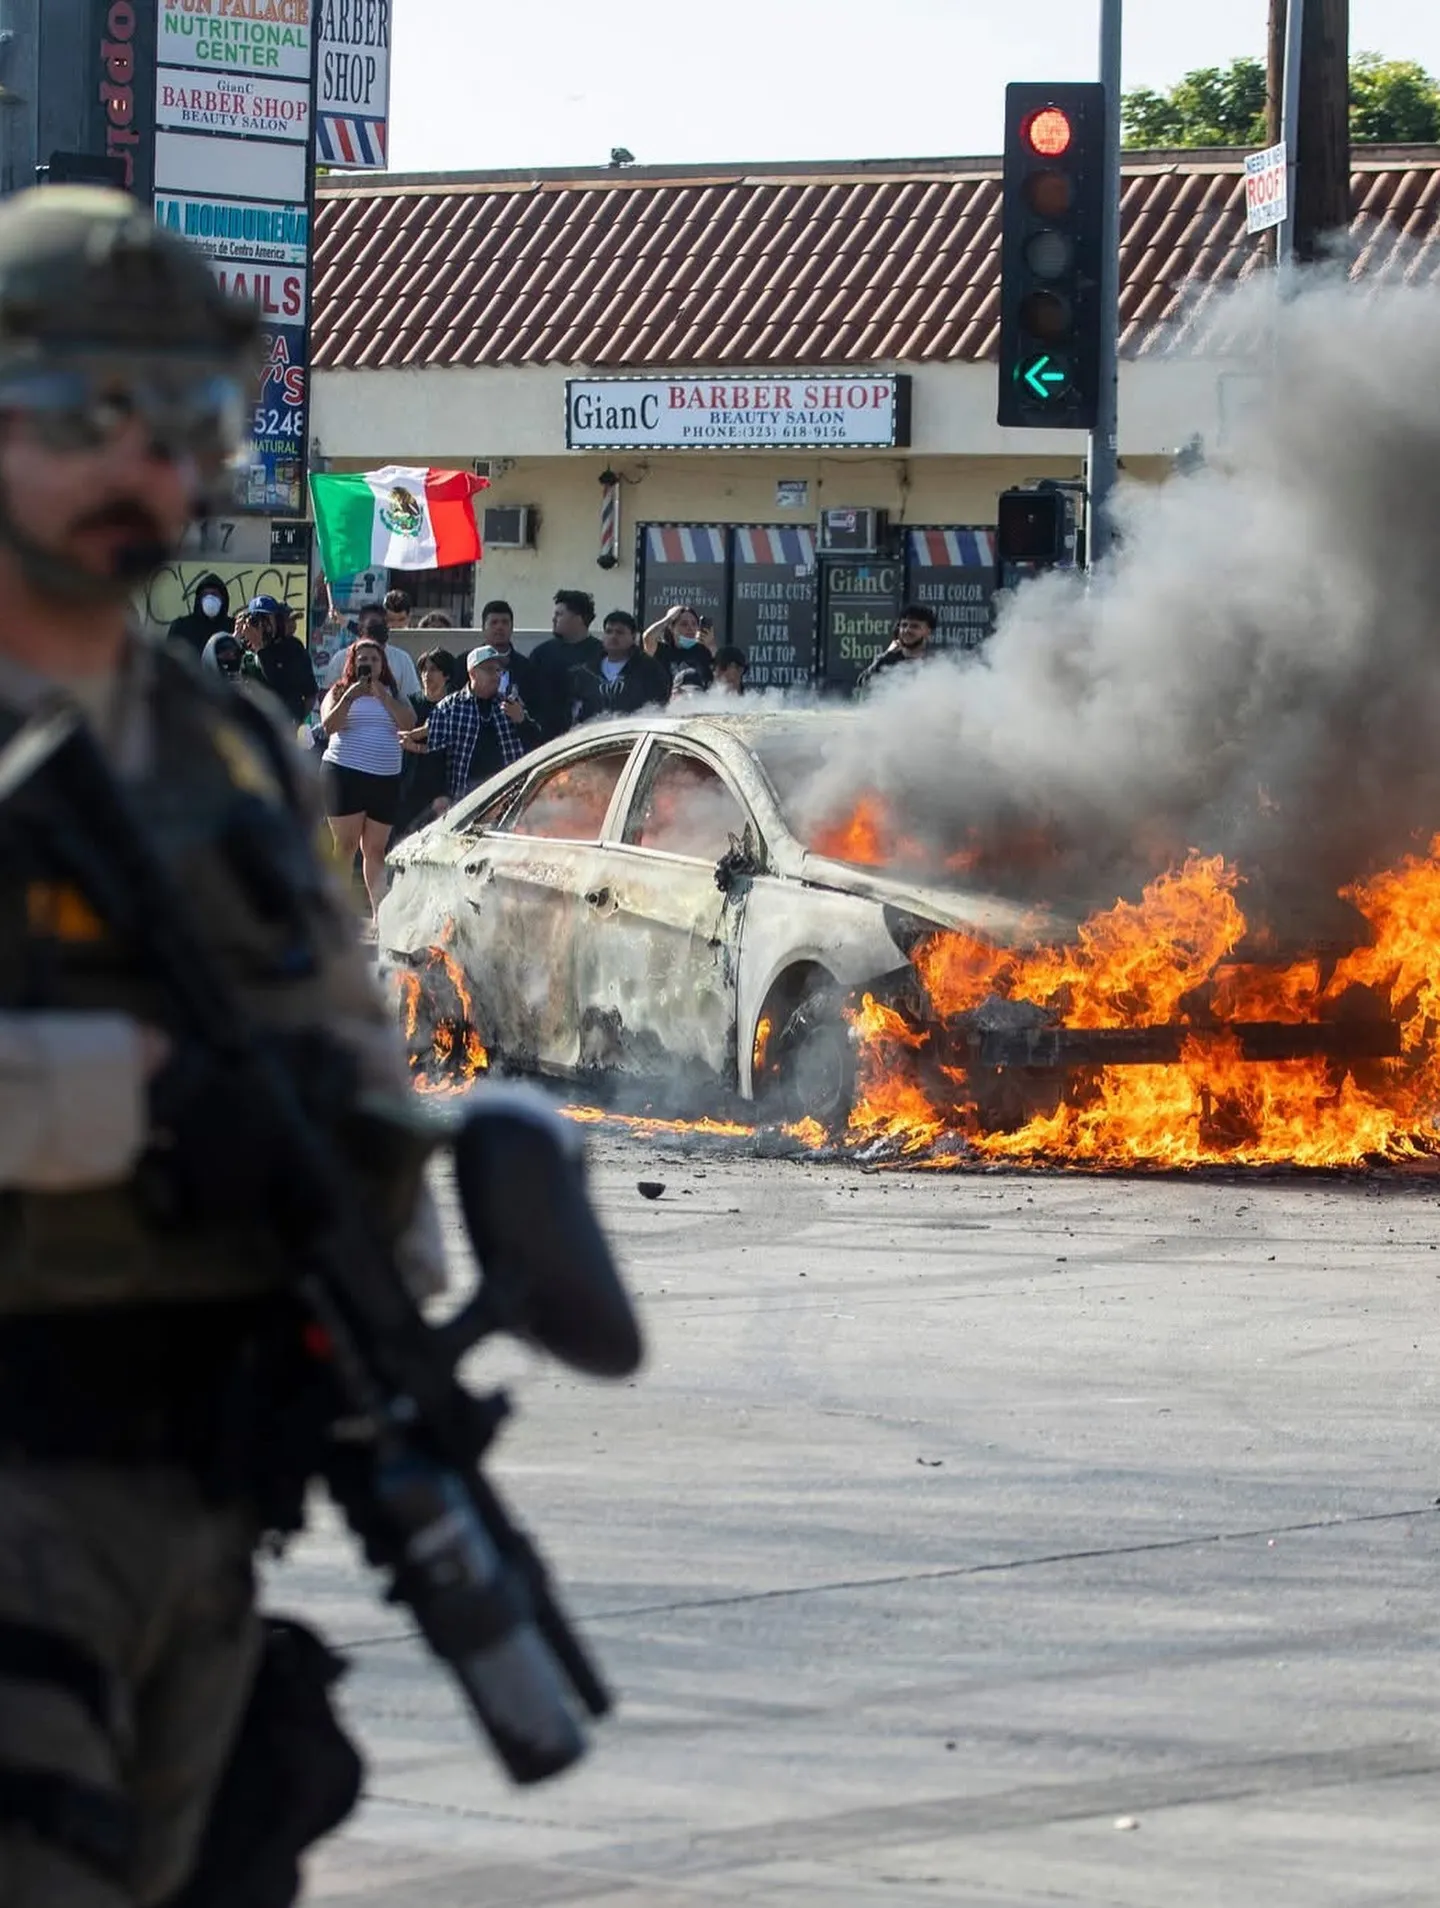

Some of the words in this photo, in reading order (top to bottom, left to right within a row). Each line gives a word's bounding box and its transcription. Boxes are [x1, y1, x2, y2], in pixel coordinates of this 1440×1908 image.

[218, 0, 308, 25] PALACE
[165, 12, 308, 48] NUTRITIONAL
[196, 40, 279, 67] CENTER
[217, 79, 254, 94] GianC
[324, 51, 375, 104] SHOP
[162, 86, 244, 114] BARBER
[252, 96, 307, 121] SHOP
[182, 110, 235, 126] BEAUTY
[242, 117, 287, 131] SALON
[230, 242, 253, 256] Centro
[255, 246, 285, 260] America
[573, 394, 659, 430] GianC
[668, 386, 793, 409] BARBER
[803, 385, 889, 409] SHOP
[710, 411, 779, 425] BEAUTY
[785, 411, 845, 425] SALON
[829, 567, 895, 593] GianC
[738, 583, 783, 600] REGULAR
[785, 583, 813, 600] CUTS
[918, 584, 945, 600] HAIR
[948, 584, 983, 601] COLOR
[758, 604, 789, 620] FADES
[833, 612, 892, 634] Barber
[756, 625, 789, 641] TAPER
[750, 646, 775, 662] FLAT
[776, 646, 797, 662] TOP
[743, 667, 769, 684] ARD
[772, 667, 808, 684] STYLES
